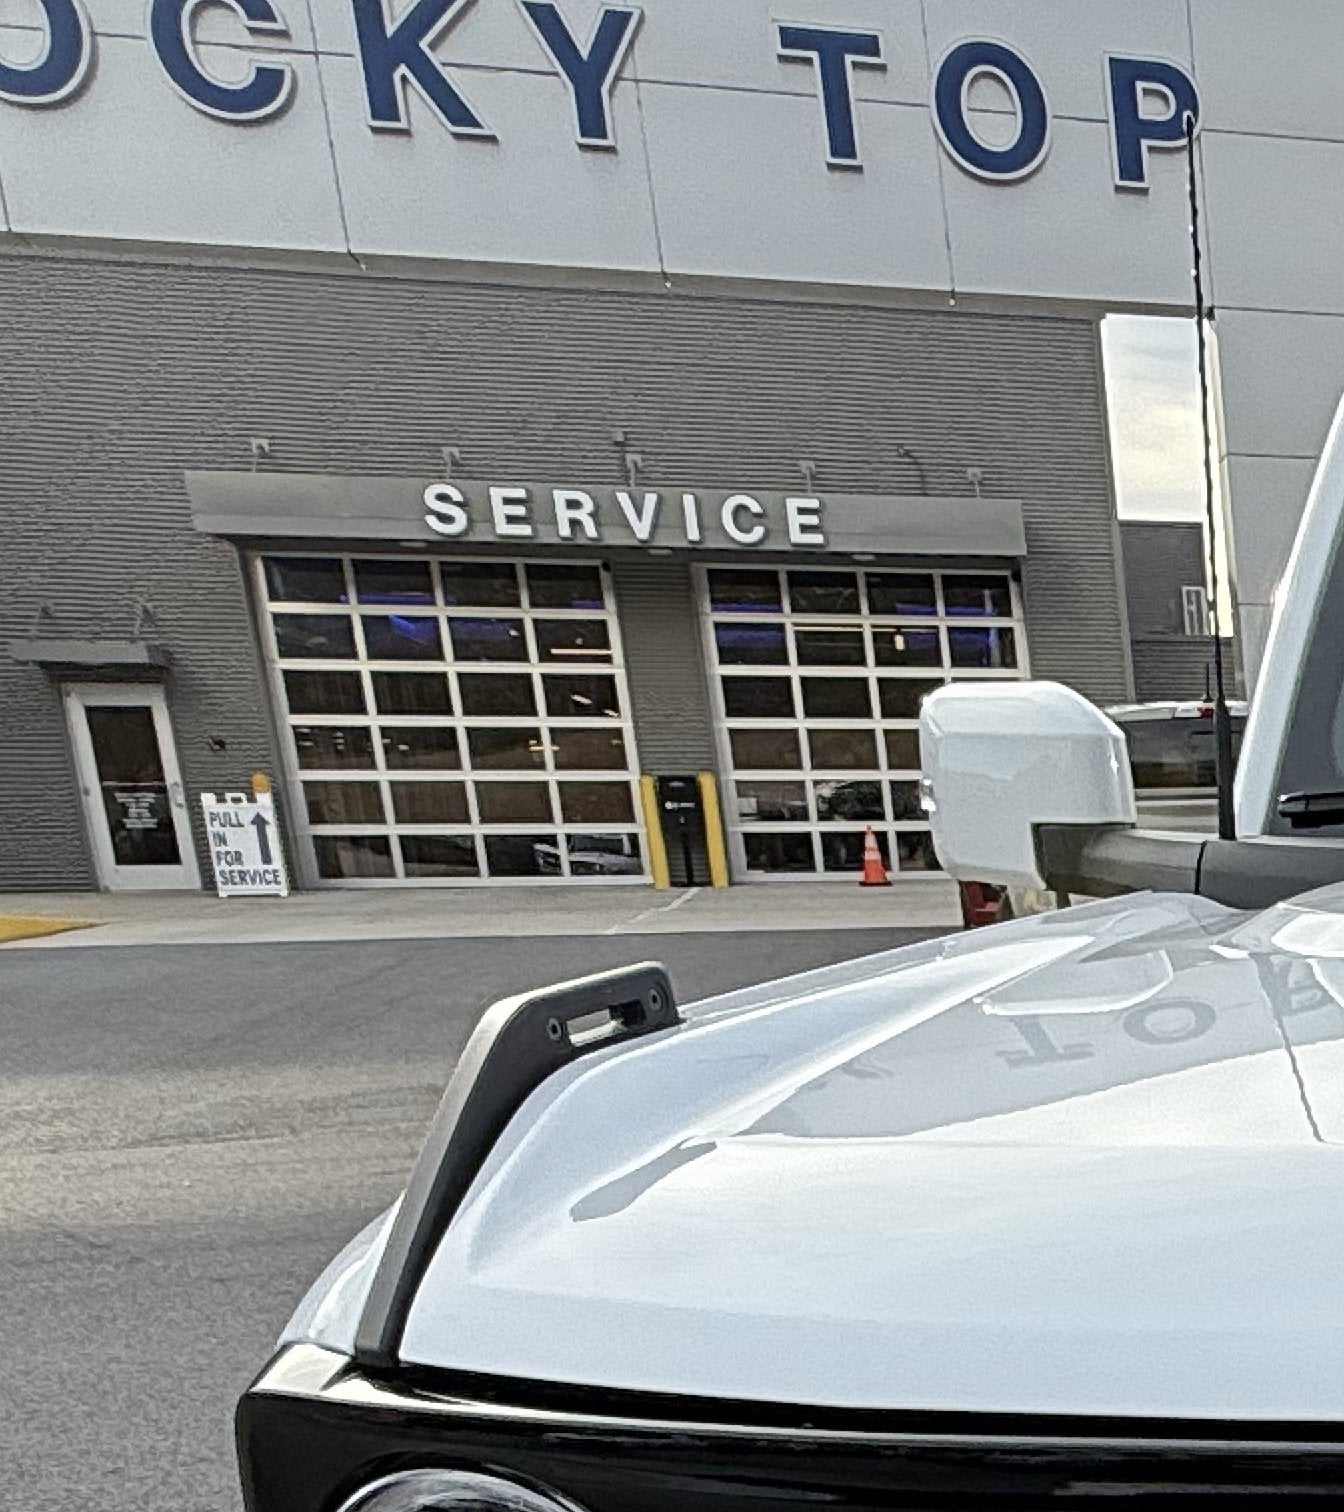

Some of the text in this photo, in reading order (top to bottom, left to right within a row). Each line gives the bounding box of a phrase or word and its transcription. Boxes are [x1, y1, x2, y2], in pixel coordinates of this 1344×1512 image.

[776, 20, 1201, 190] TOP
[422, 483, 826, 545] SERVICE
[208, 811, 245, 828] PULL
[212, 831, 228, 848] IN
[216, 850, 244, 867] FOR
[219, 868, 281, 886] SERVICE
